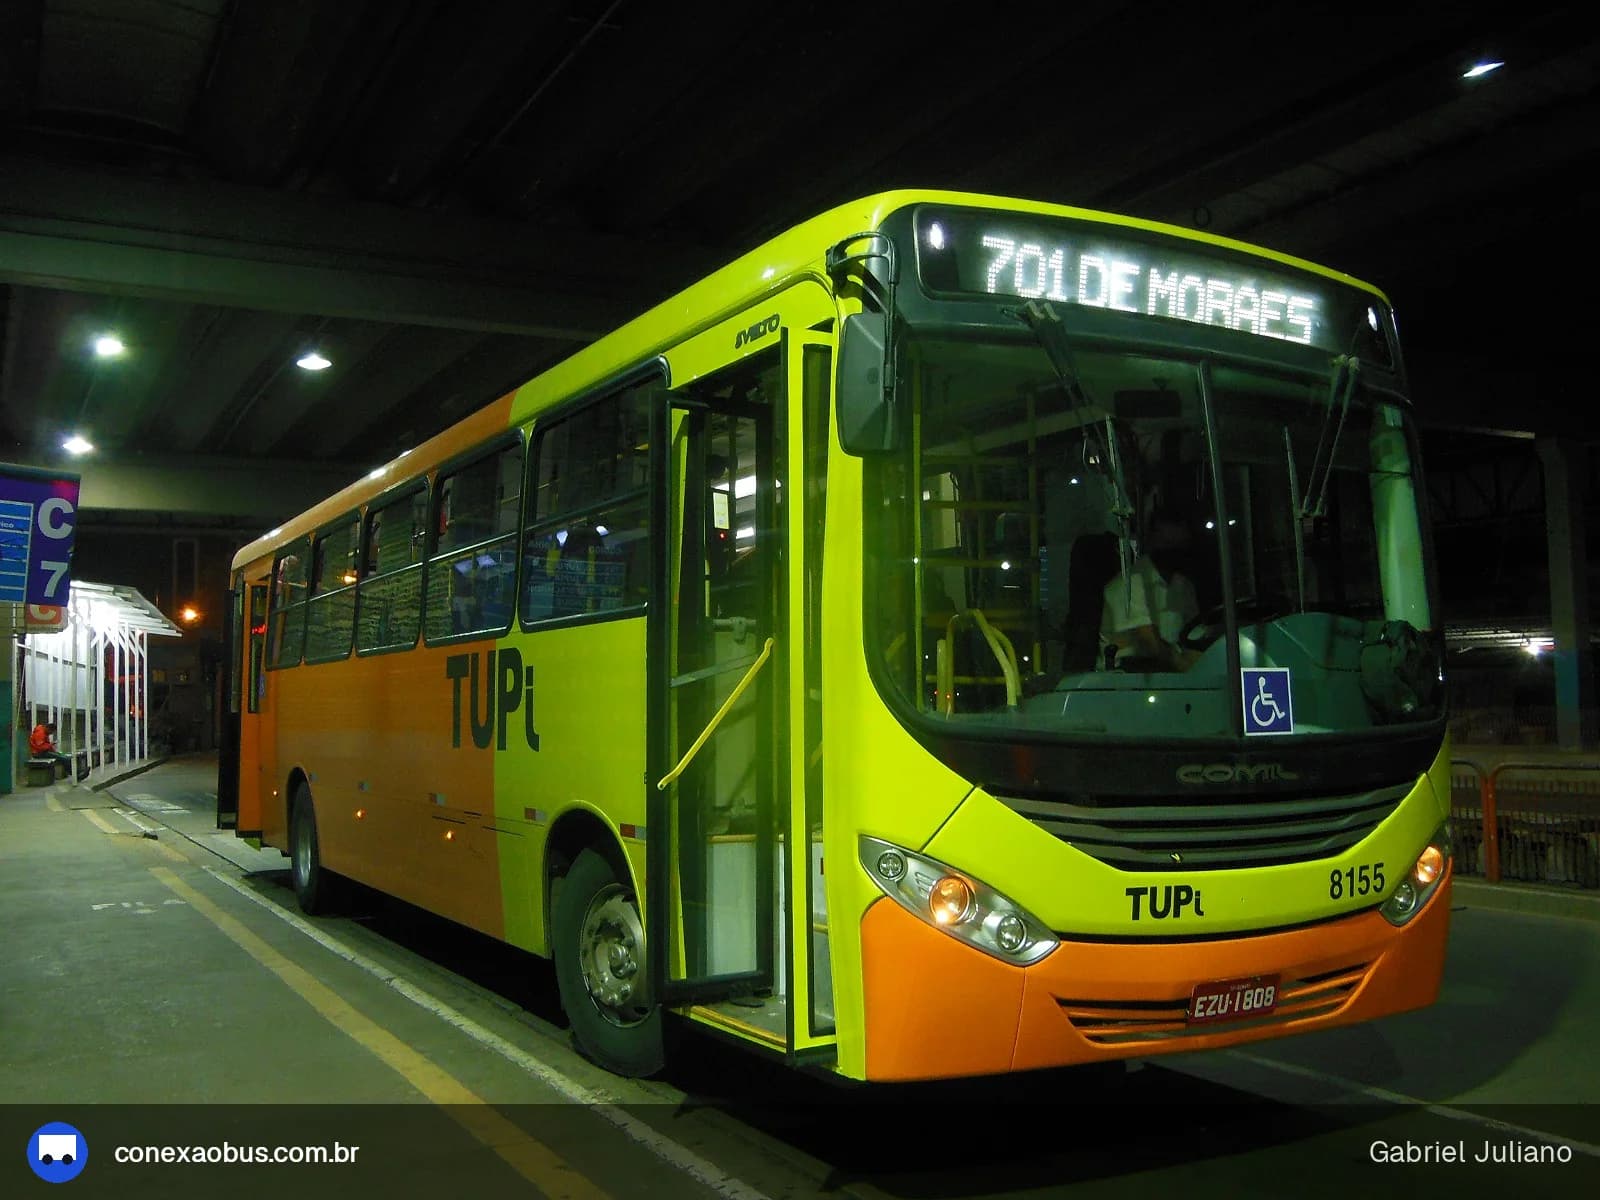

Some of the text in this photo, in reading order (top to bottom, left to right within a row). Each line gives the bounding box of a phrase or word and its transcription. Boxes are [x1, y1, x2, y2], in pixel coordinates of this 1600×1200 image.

[982, 235, 1314, 345] 701 DE MORAES
[38, 497, 74, 539] C
[40, 560, 68, 598] 7
[1176, 764, 1299, 784] COMIL
[1329, 862, 1385, 900] 8155
